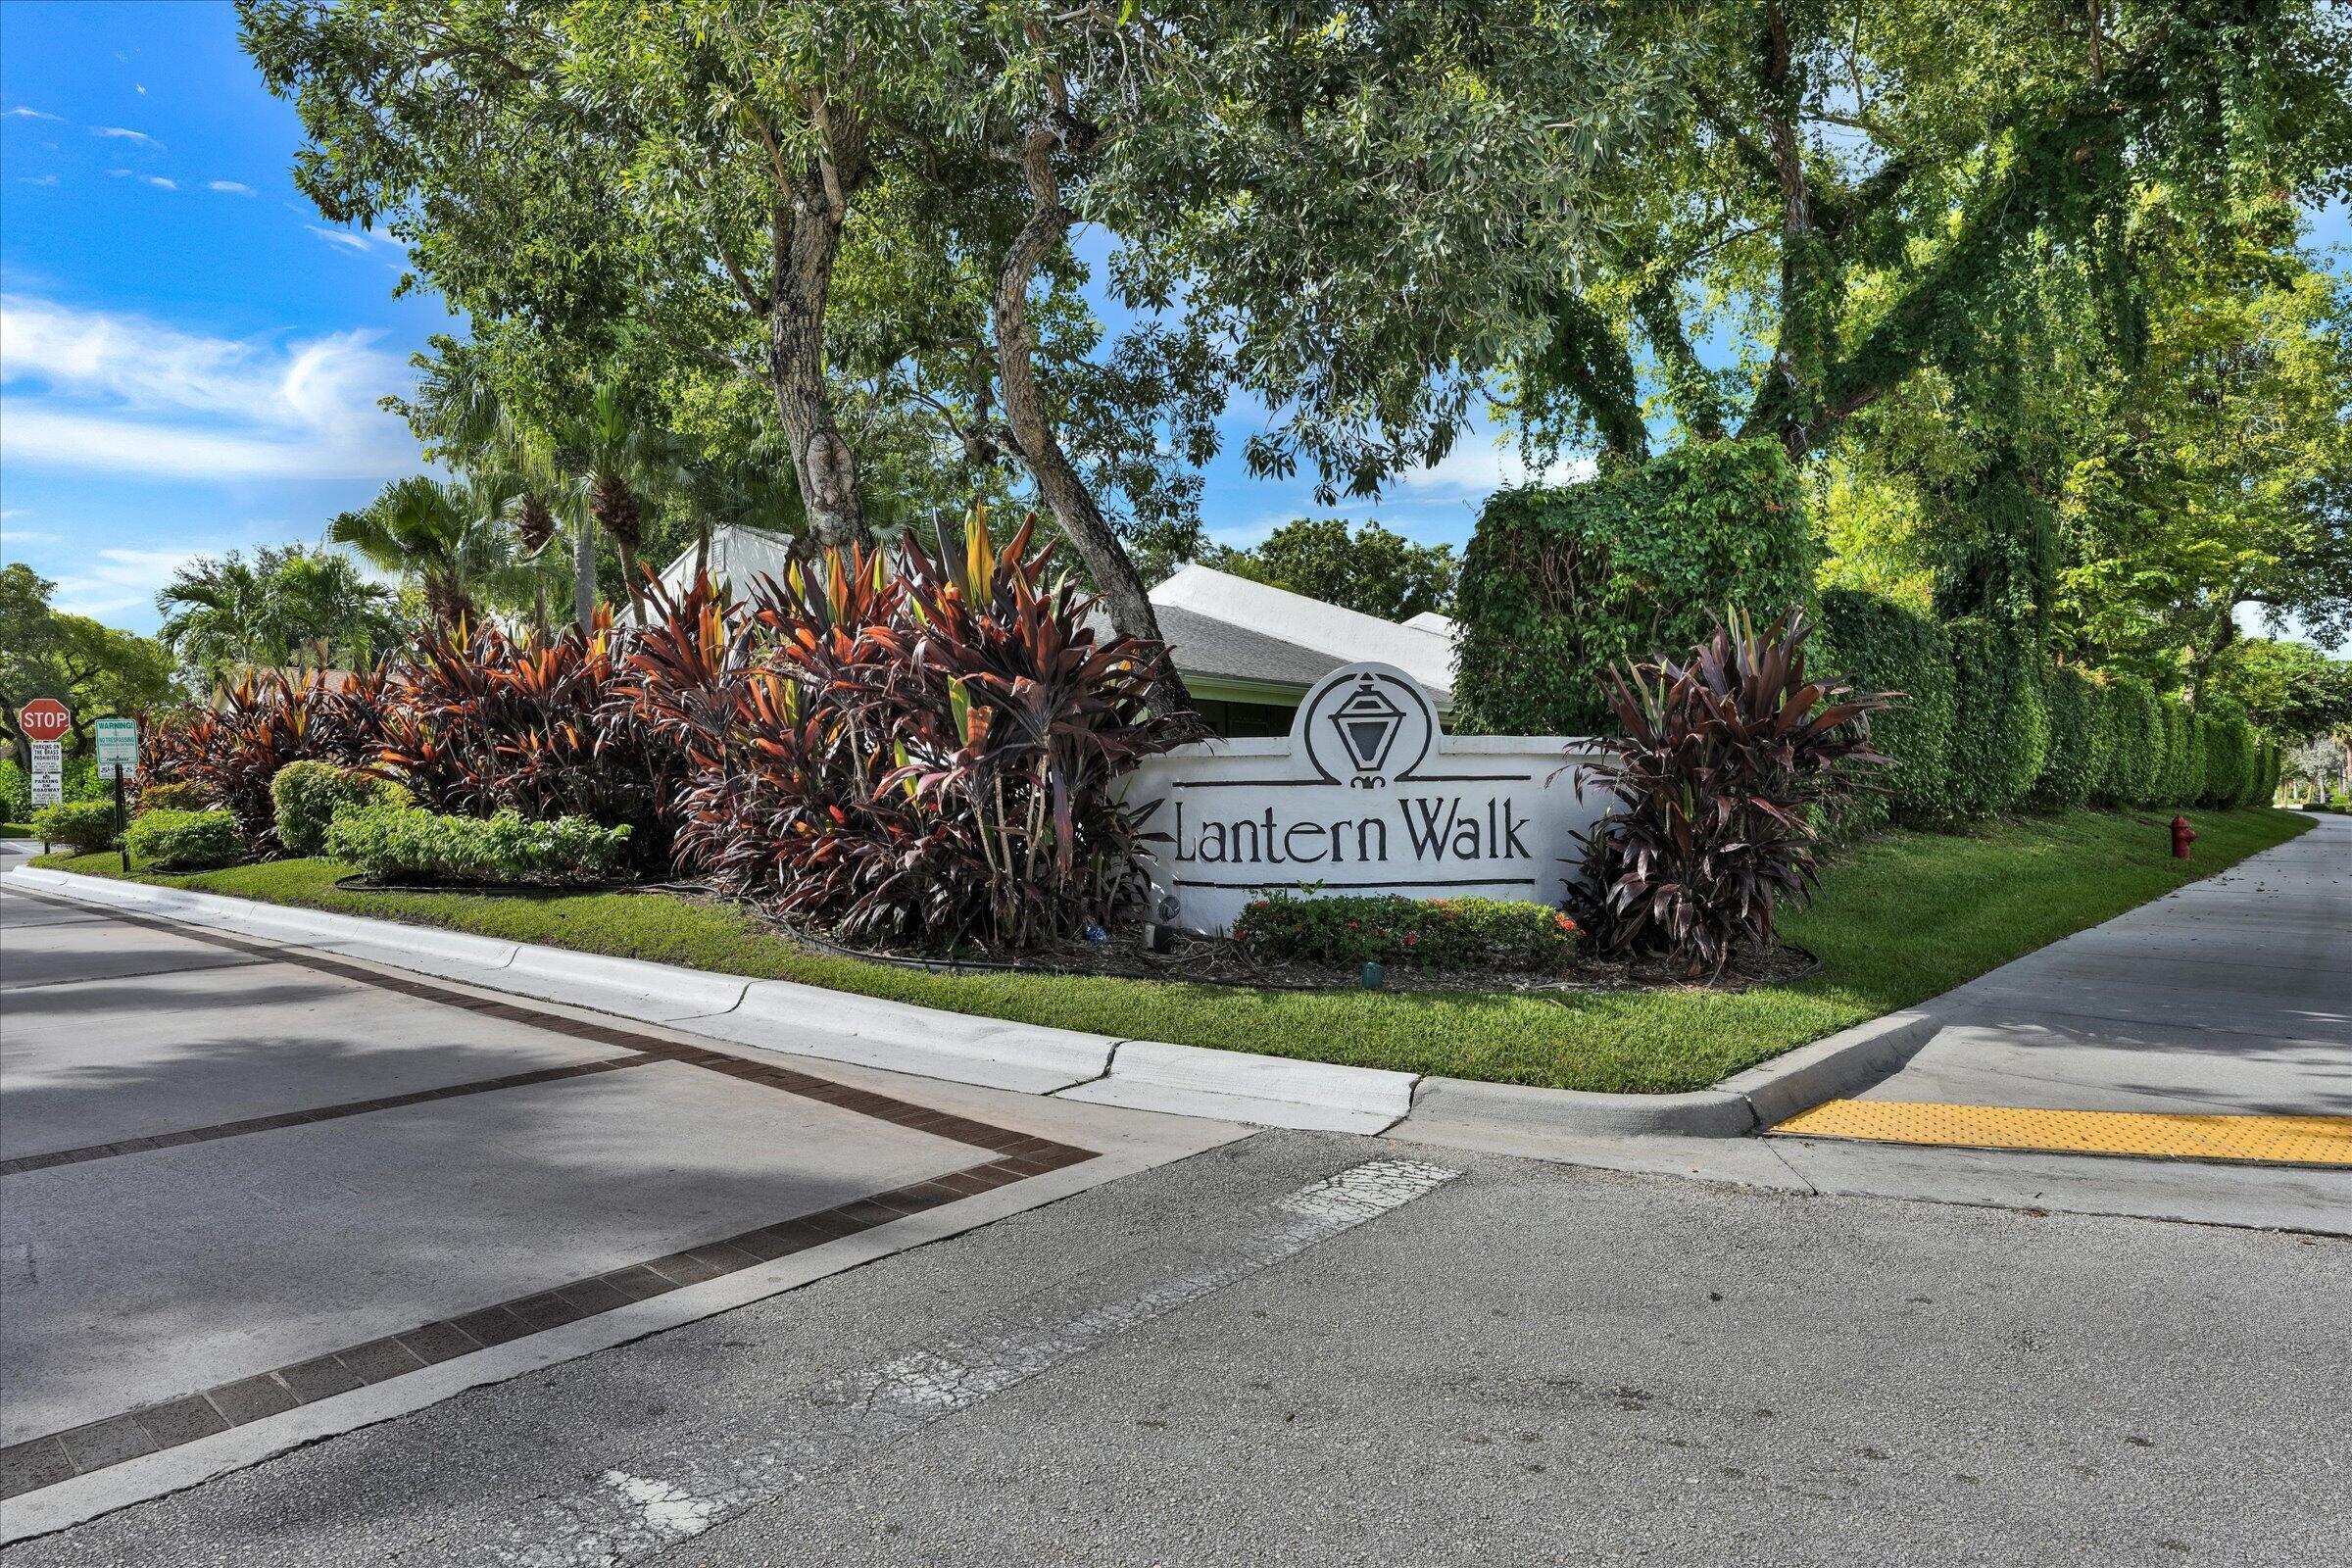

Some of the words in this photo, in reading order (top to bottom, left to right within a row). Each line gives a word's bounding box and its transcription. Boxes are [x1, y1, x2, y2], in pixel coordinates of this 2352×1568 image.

[24, 711, 67, 727] STOP
[1174, 801, 1388, 863] Lantern
[1397, 796, 1533, 861] Walk
